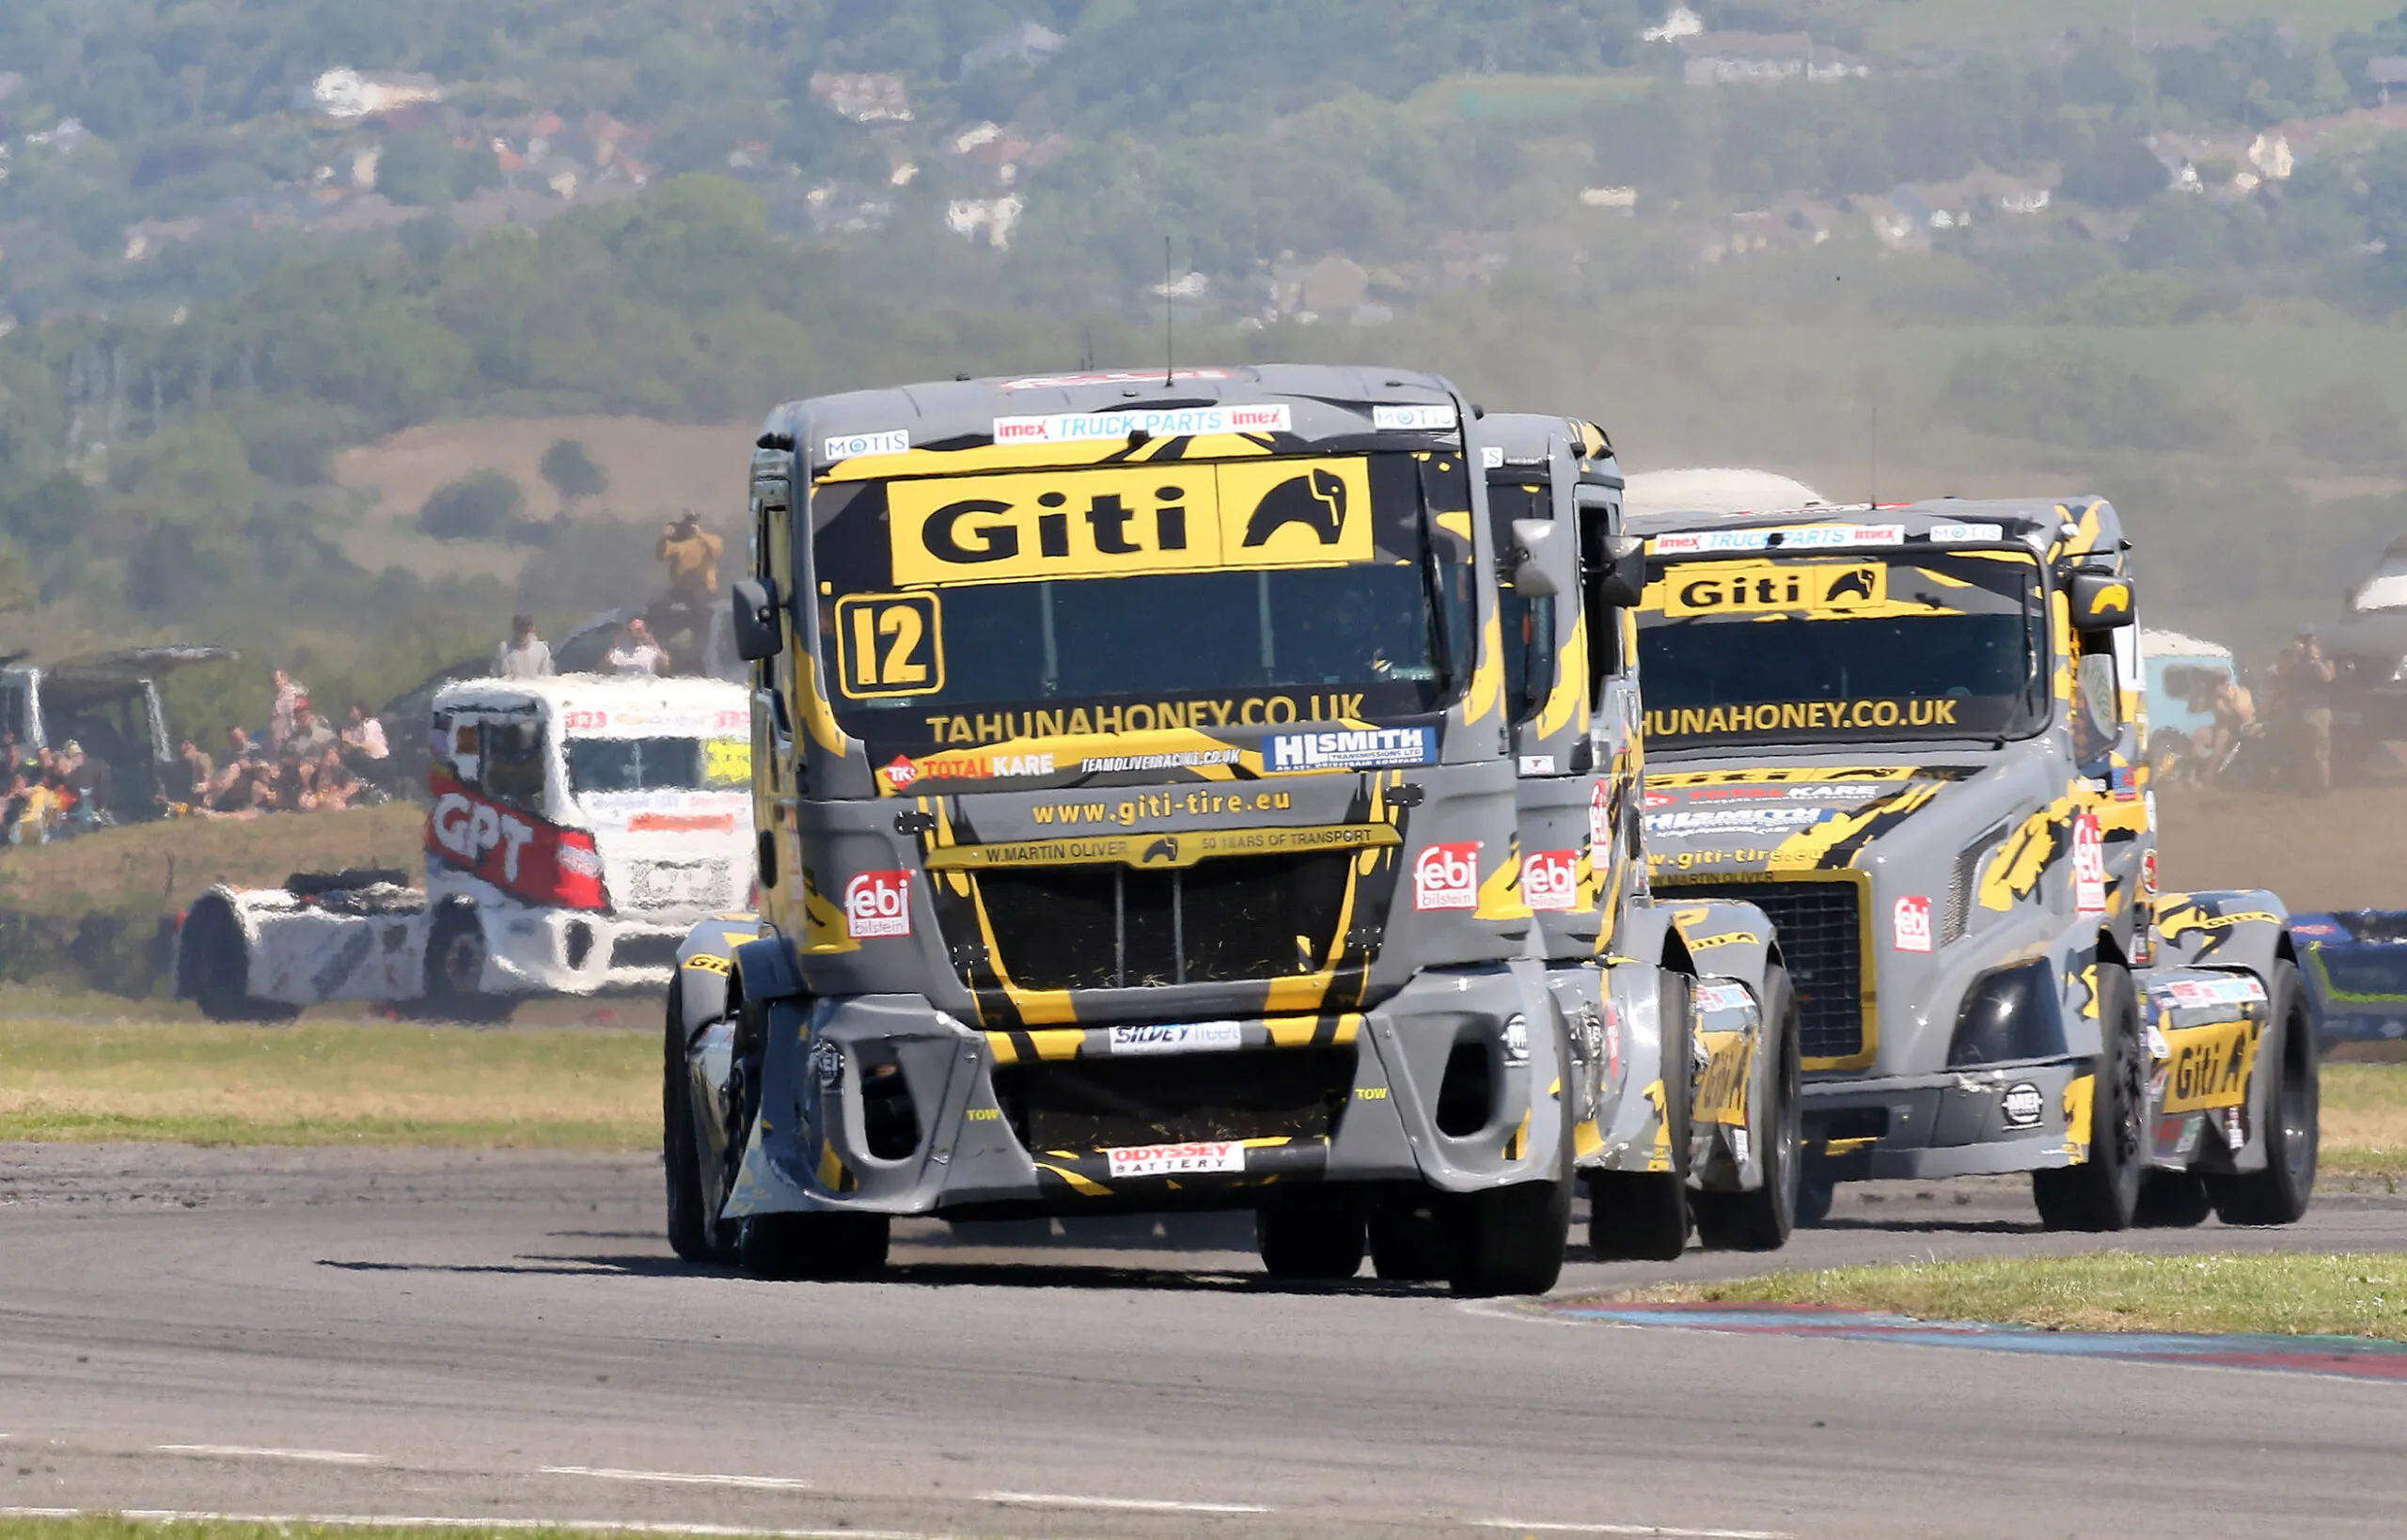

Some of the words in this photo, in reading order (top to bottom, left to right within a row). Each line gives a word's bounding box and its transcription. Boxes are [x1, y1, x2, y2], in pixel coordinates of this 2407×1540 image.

[999, 419, 1047, 439] imex
[1060, 414, 1134, 437] TRUCK
[1145, 411, 1222, 433] PARTS
[1232, 408, 1281, 427] imex
[827, 432, 907, 458] MOTIS
[921, 485, 1187, 564] Giti
[1660, 536, 1702, 550] imex
[1783, 530, 1847, 545] PARTS
[1853, 528, 1896, 542] imex
[1680, 575, 1800, 608] Giti
[853, 605, 927, 685] 12
[926, 693, 1364, 744] TAHUNAHONEY.CO.UK
[1642, 699, 1958, 738] HUNAHONEY.CO.UK
[1274, 730, 1424, 766] HISMITH
[924, 752, 1055, 779] TOTALKARE
[1032, 791, 1292, 825] www.giti-tire.eu
[433, 793, 533, 883] GPT
[1069, 840, 1128, 857] OLIVER
[1267, 833, 1287, 847] OF
[1291, 829, 1372, 844] TRANSPORT
[1415, 845, 1478, 891] febi
[1520, 853, 1577, 892] febi
[845, 872, 910, 919] febi
[1421, 891, 1472, 907] bilstein
[854, 919, 905, 935] bilstein
[2176, 1042, 2221, 1101] Giti
[1355, 1088, 1388, 1100] TOW
[968, 1108, 999, 1121] TOW
[1113, 1143, 1233, 1162] ODYSSEY
[1115, 1158, 1225, 1173] BATTERY
